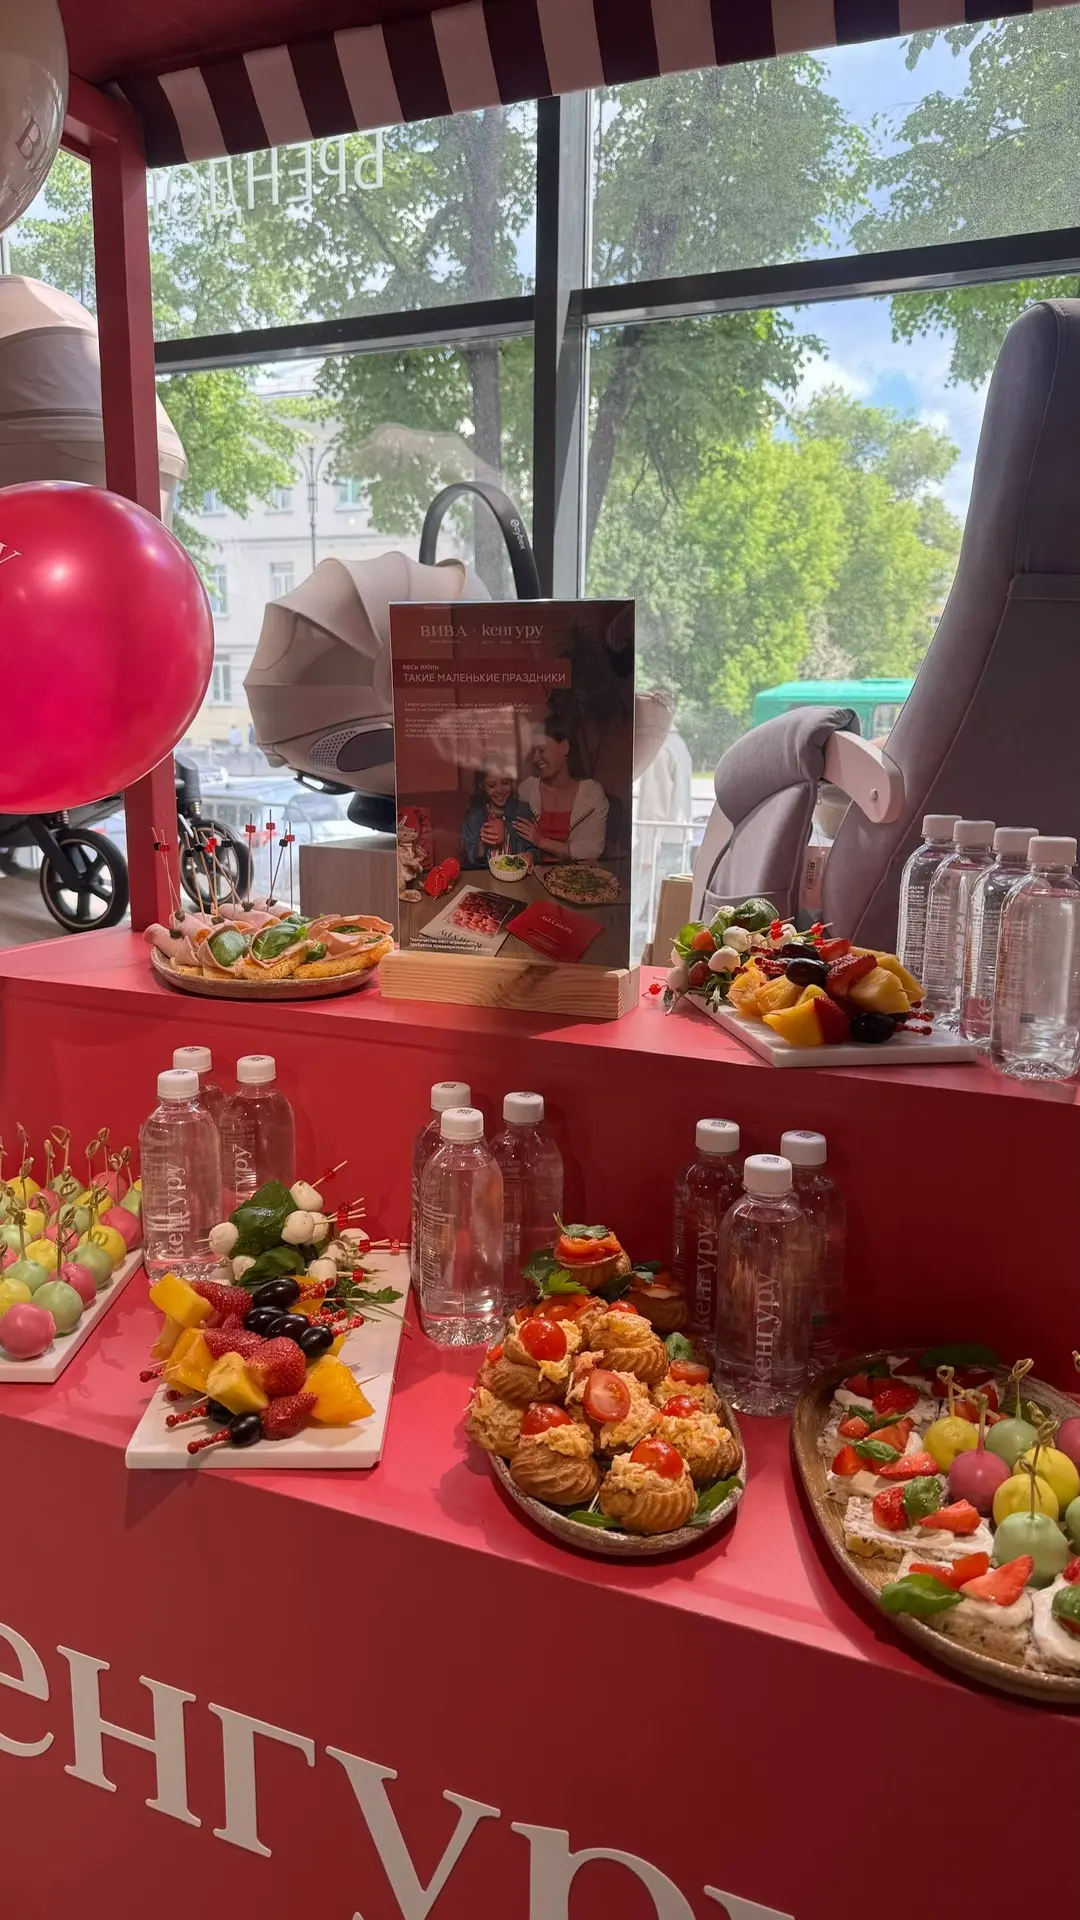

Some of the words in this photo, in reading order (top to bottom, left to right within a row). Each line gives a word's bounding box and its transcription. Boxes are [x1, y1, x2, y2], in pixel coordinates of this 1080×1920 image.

[403, 673, 436, 683] ТАКИЕ
[437, 673, 500, 683] МАЛЕНЬКИЕ
[502, 673, 566, 684] ПРАЗДНИКИ
[482, 623, 544, 639] кенгуру
[163, 1162, 190, 1259] кенгуру
[692, 1222, 719, 1332] кенгуру
[749, 1271, 782, 1389] кенгуру
